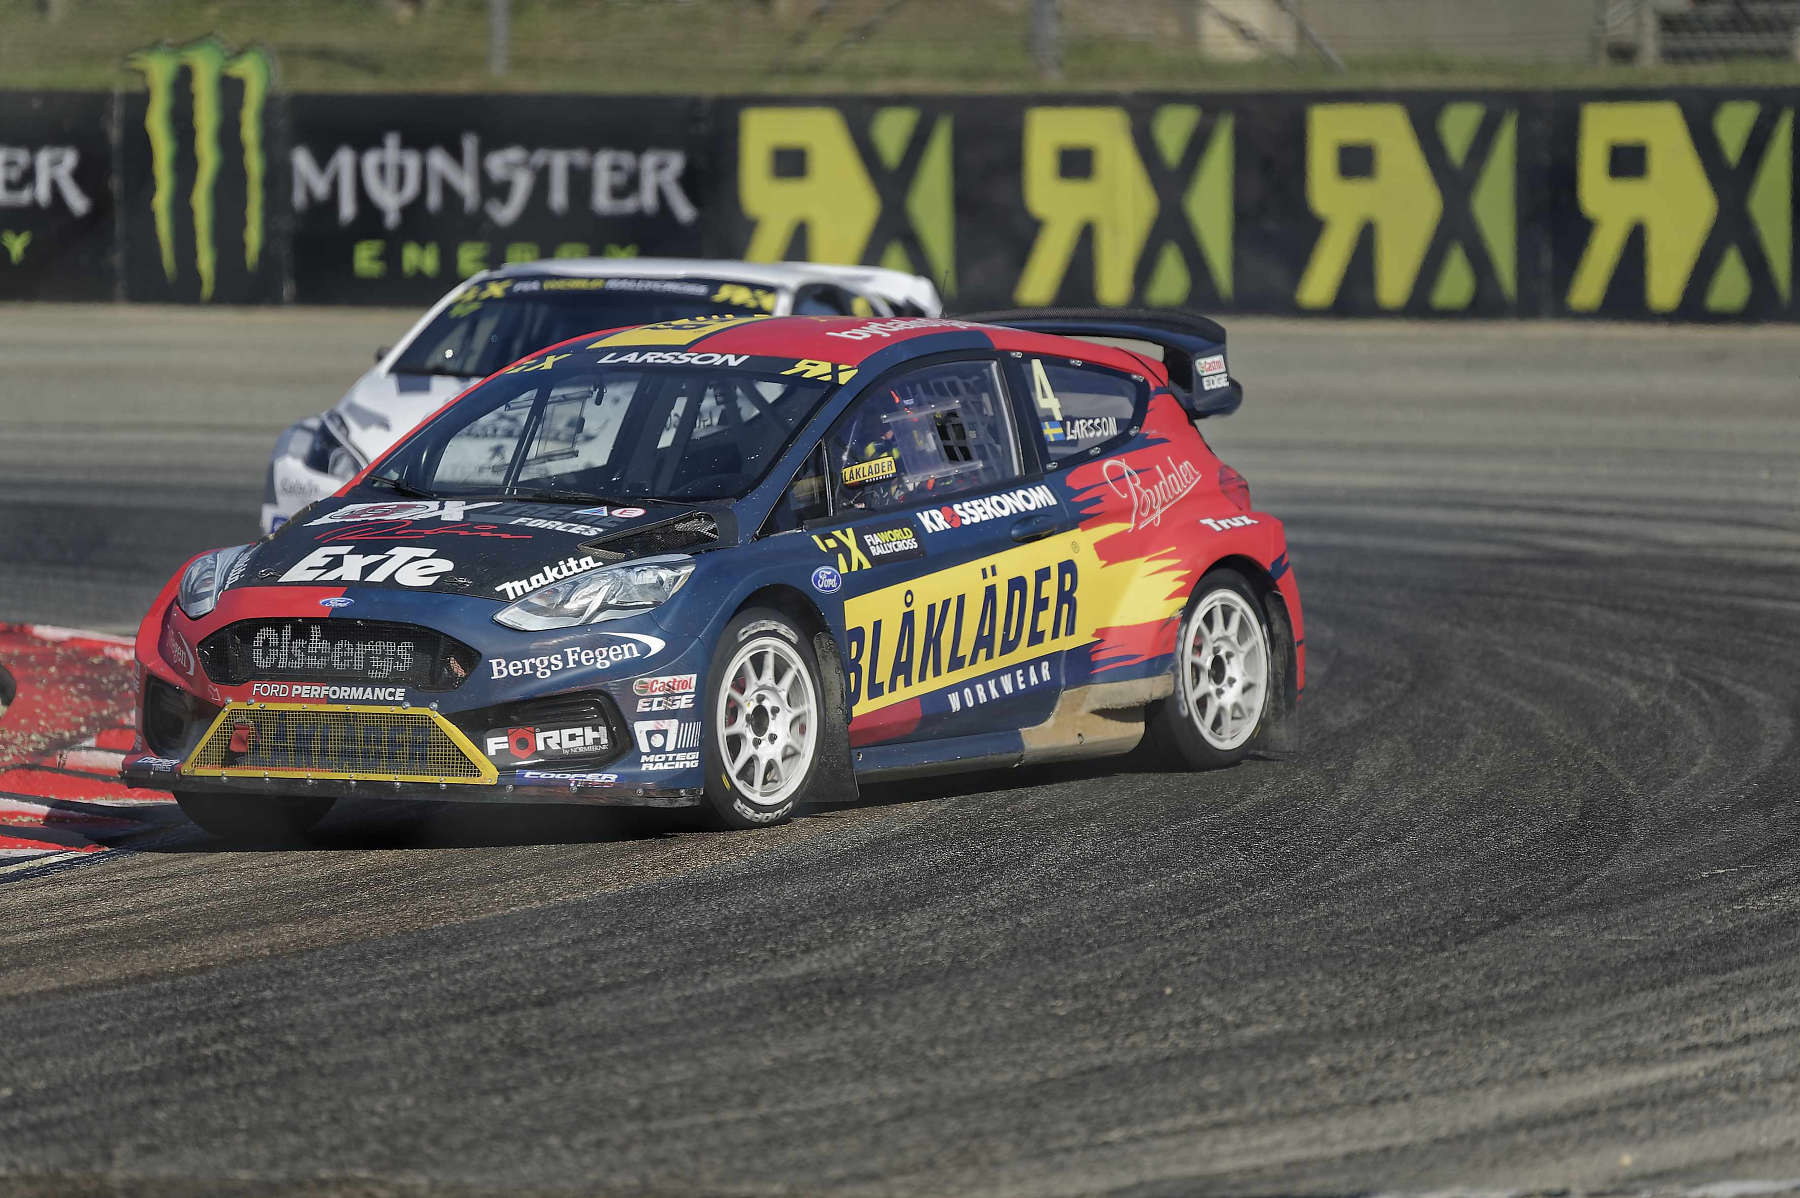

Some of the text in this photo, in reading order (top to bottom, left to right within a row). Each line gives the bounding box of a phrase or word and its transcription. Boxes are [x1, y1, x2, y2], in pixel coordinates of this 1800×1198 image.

[291, 132, 697, 226] MONSTER
[1012, 104, 1235, 306] RX
[1296, 103, 1518, 309] RX
[1567, 101, 1795, 311] RX
[597, 351, 750, 367] LARSSON
[1031, 358, 1063, 421] 4
[1066, 416, 1119, 440] LARSSON
[916, 485, 1058, 533] KROSSEKONOMI
[509, 517, 604, 536] FORCES
[869, 538, 918, 556] RALLYCROSS
[817, 569, 837, 589] Ford
[846, 559, 1078, 708] BLÅKLÄDER
[488, 642, 641, 680] Bergs Fegen
[252, 684, 406, 701] FORD PERFORMANCE
[649, 676, 693, 693] Castrol
[948, 661, 1050, 713] WORKWEAR
[636, 694, 696, 712] EDGE
[640, 752, 700, 763] MOTEGI
[640, 760, 699, 771] RACING
[523, 771, 619, 783] COOPER
